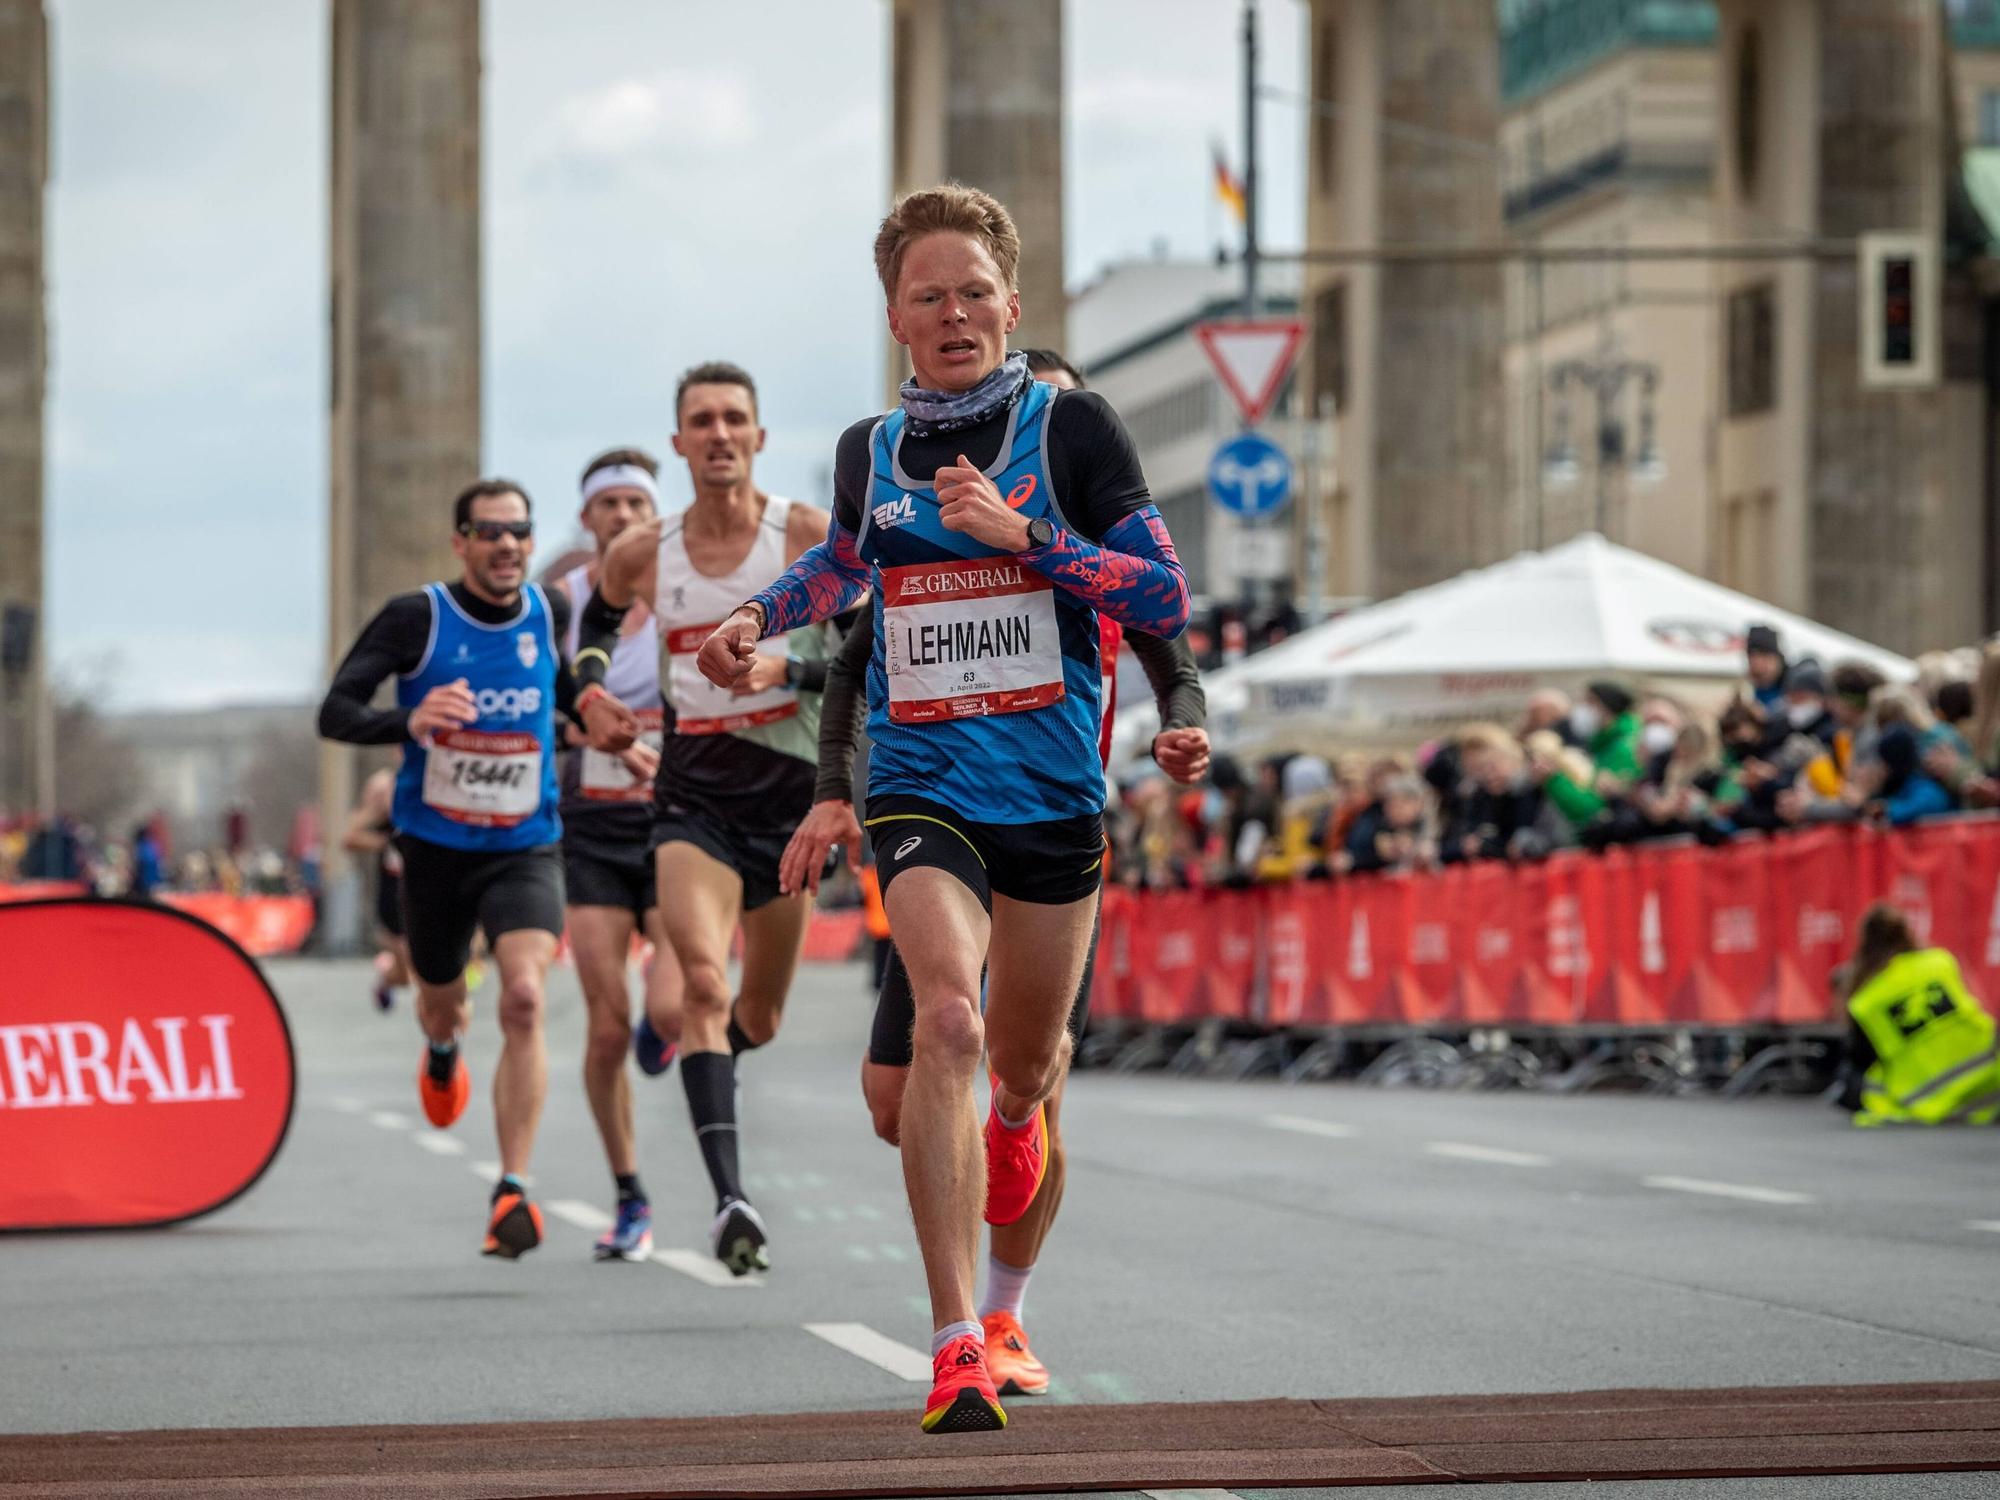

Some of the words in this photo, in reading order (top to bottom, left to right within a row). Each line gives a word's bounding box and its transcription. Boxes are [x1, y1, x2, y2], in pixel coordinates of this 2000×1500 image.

[926, 565, 1024, 593] GENERALI
[1066, 560, 1105, 587] asics
[908, 615, 1031, 666] LEHMANN
[957, 683, 973, 691] April
[963, 672, 975, 682] 63
[452, 761, 527, 788] 15447
[0, 1014, 245, 1109] ERALI
